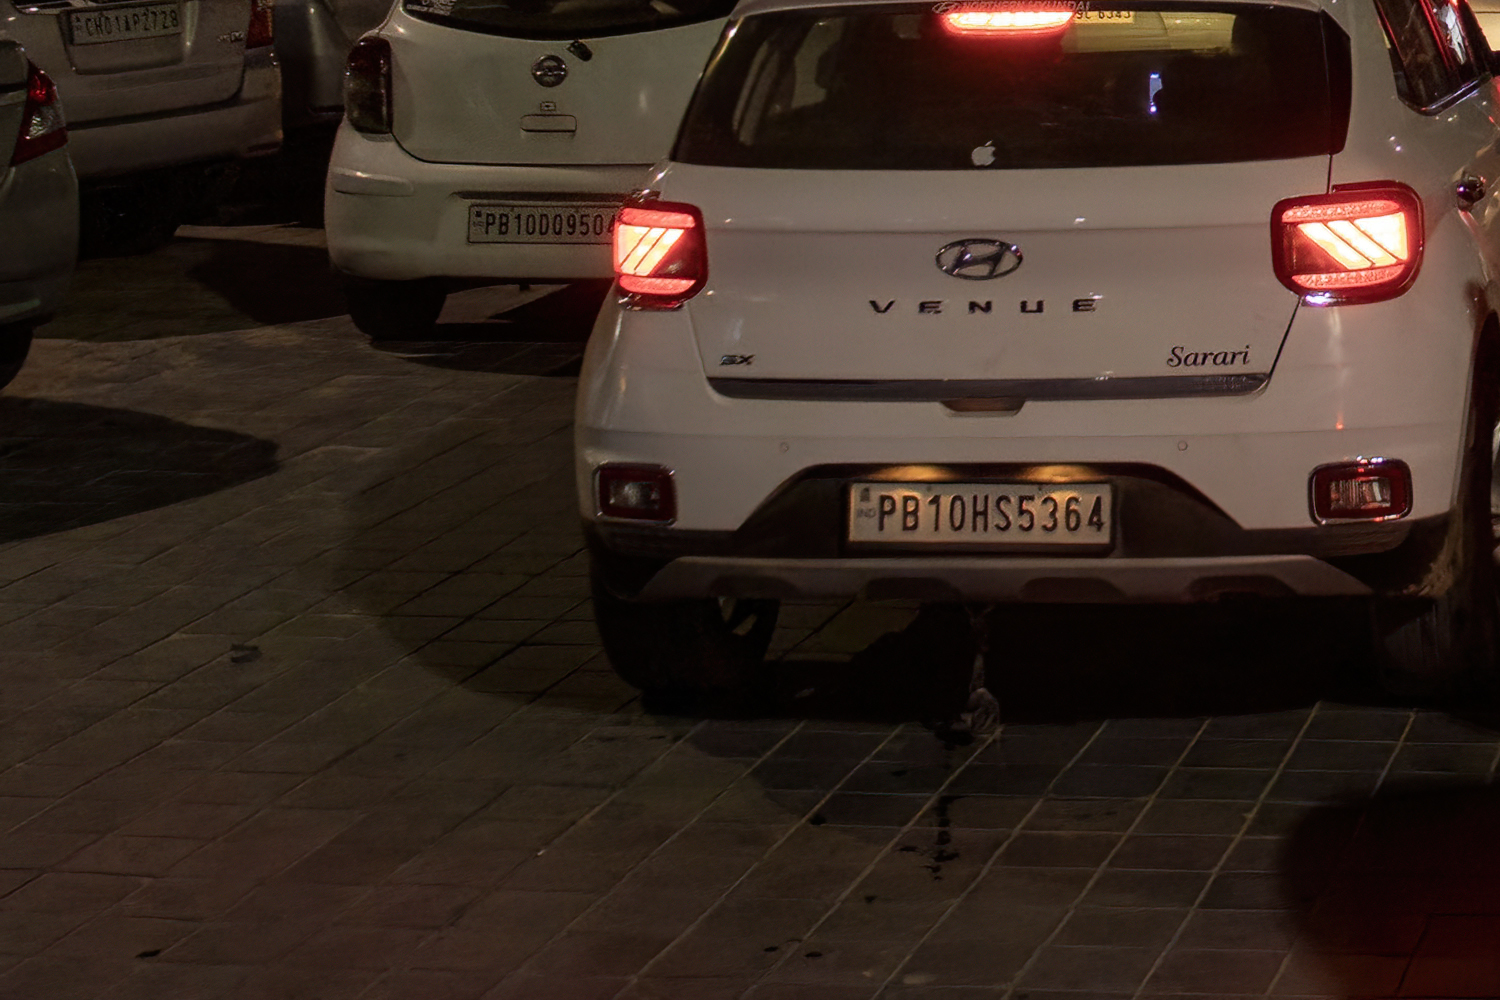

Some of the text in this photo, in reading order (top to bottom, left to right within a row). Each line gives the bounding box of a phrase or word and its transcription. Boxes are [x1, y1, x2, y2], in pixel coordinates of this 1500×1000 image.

[869, 298, 1098, 314] VENUE
[1166, 344, 1251, 368] Sarari
[878, 494, 1104, 532] PB10HS5364
